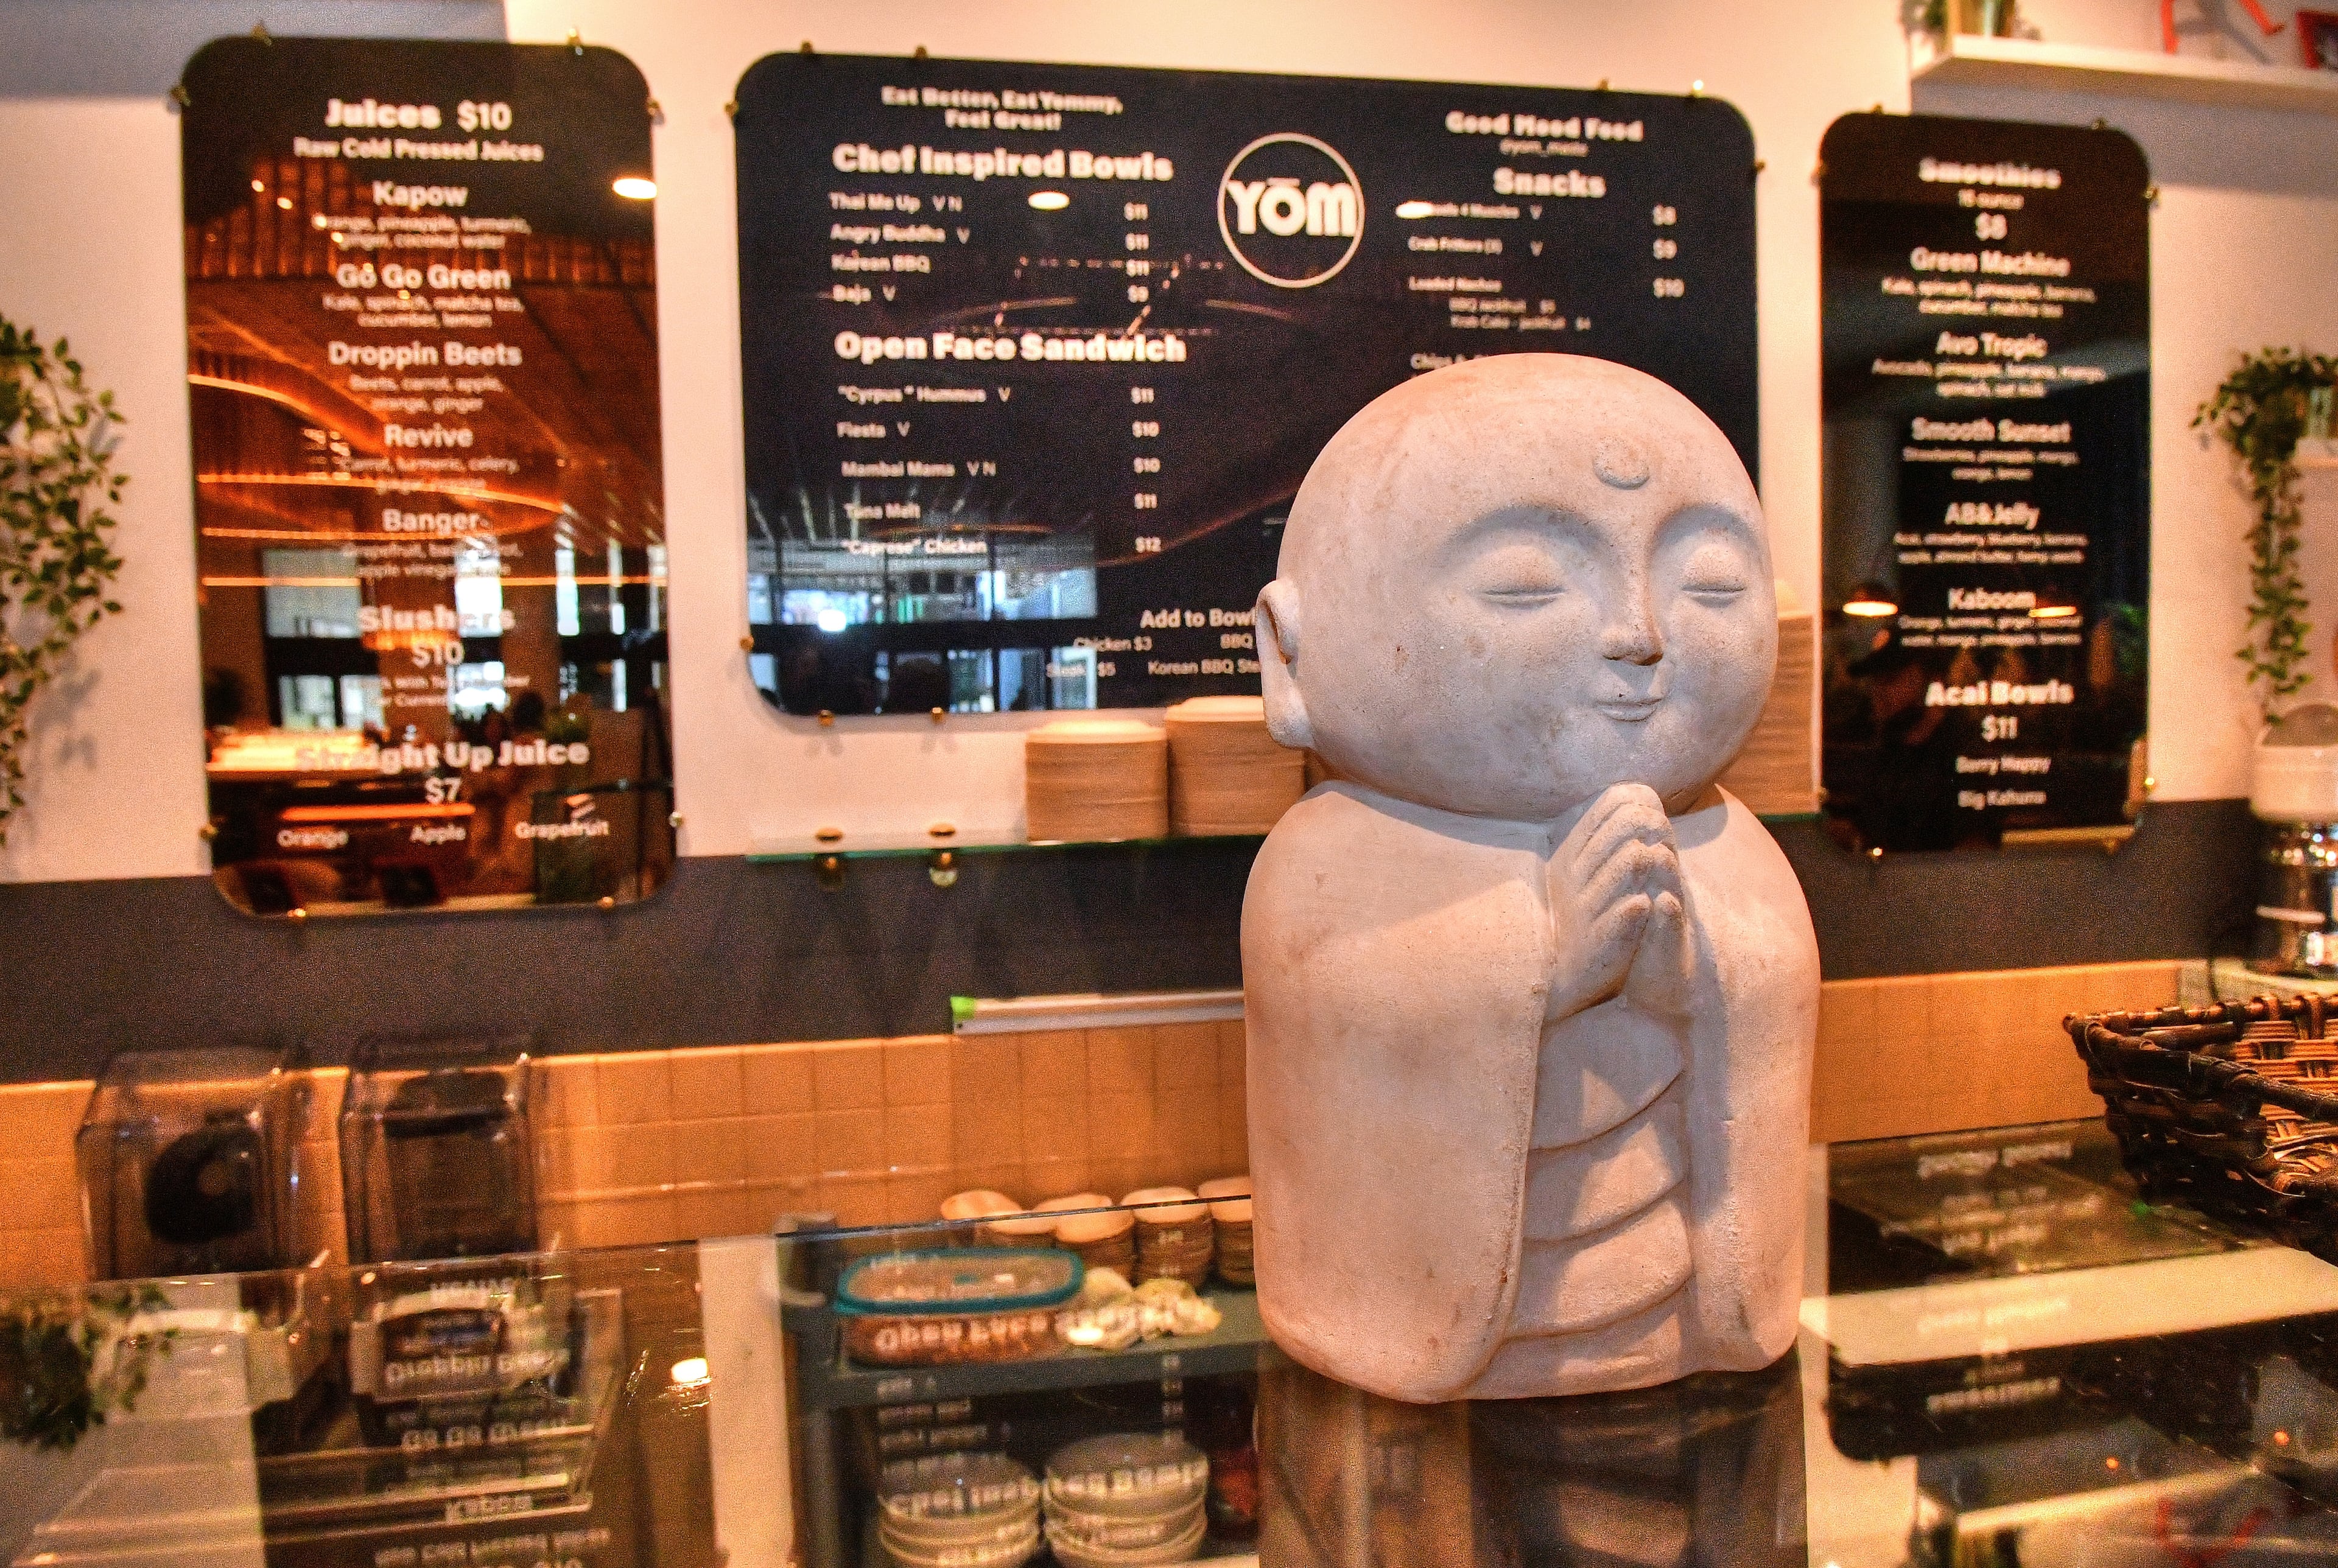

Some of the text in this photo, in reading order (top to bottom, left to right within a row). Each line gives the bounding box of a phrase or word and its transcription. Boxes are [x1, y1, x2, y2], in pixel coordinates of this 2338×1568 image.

[325, 99, 512, 132] Juices $10
[1445, 110, 1510, 135] Good
[1584, 117, 1644, 142] Food
[342, 137, 392, 158] Cold
[394, 138, 478, 160] Pressed
[480, 140, 546, 162] Juices
[832, 142, 1174, 183] Chef Inspired Bowls
[1493, 167, 1607, 198] Snacks
[1918, 156, 2062, 190] Smoothies
[372, 180, 468, 212] Kapow
[895, 194, 921, 214] Up
[932, 194, 946, 212] V
[957, 226, 970, 244] V
[1910, 246, 2071, 278] Green Machine
[336, 263, 511, 290] Go Go Green
[882, 284, 896, 302] V
[328, 341, 522, 371] Droppin Beets
[834, 331, 1187, 365] Open Face Sandwich
[997, 387, 1011, 403] V
[384, 422, 473, 448] Revive
[896, 421, 911, 438] V
[966, 460, 980, 477] V
[982, 461, 997, 477] N
[1140, 607, 1181, 628] Add
[1185, 609, 1206, 628] to
[412, 641, 465, 668] $10
[1148, 659, 1198, 676] Korean
[1201, 658, 1234, 675] BBQ
[1990, 678, 2074, 705] Bowls
[1982, 714, 2018, 742] $11
[443, 741, 494, 772] Up
[498, 738, 590, 767] Juice
[424, 776, 462, 805] $7
